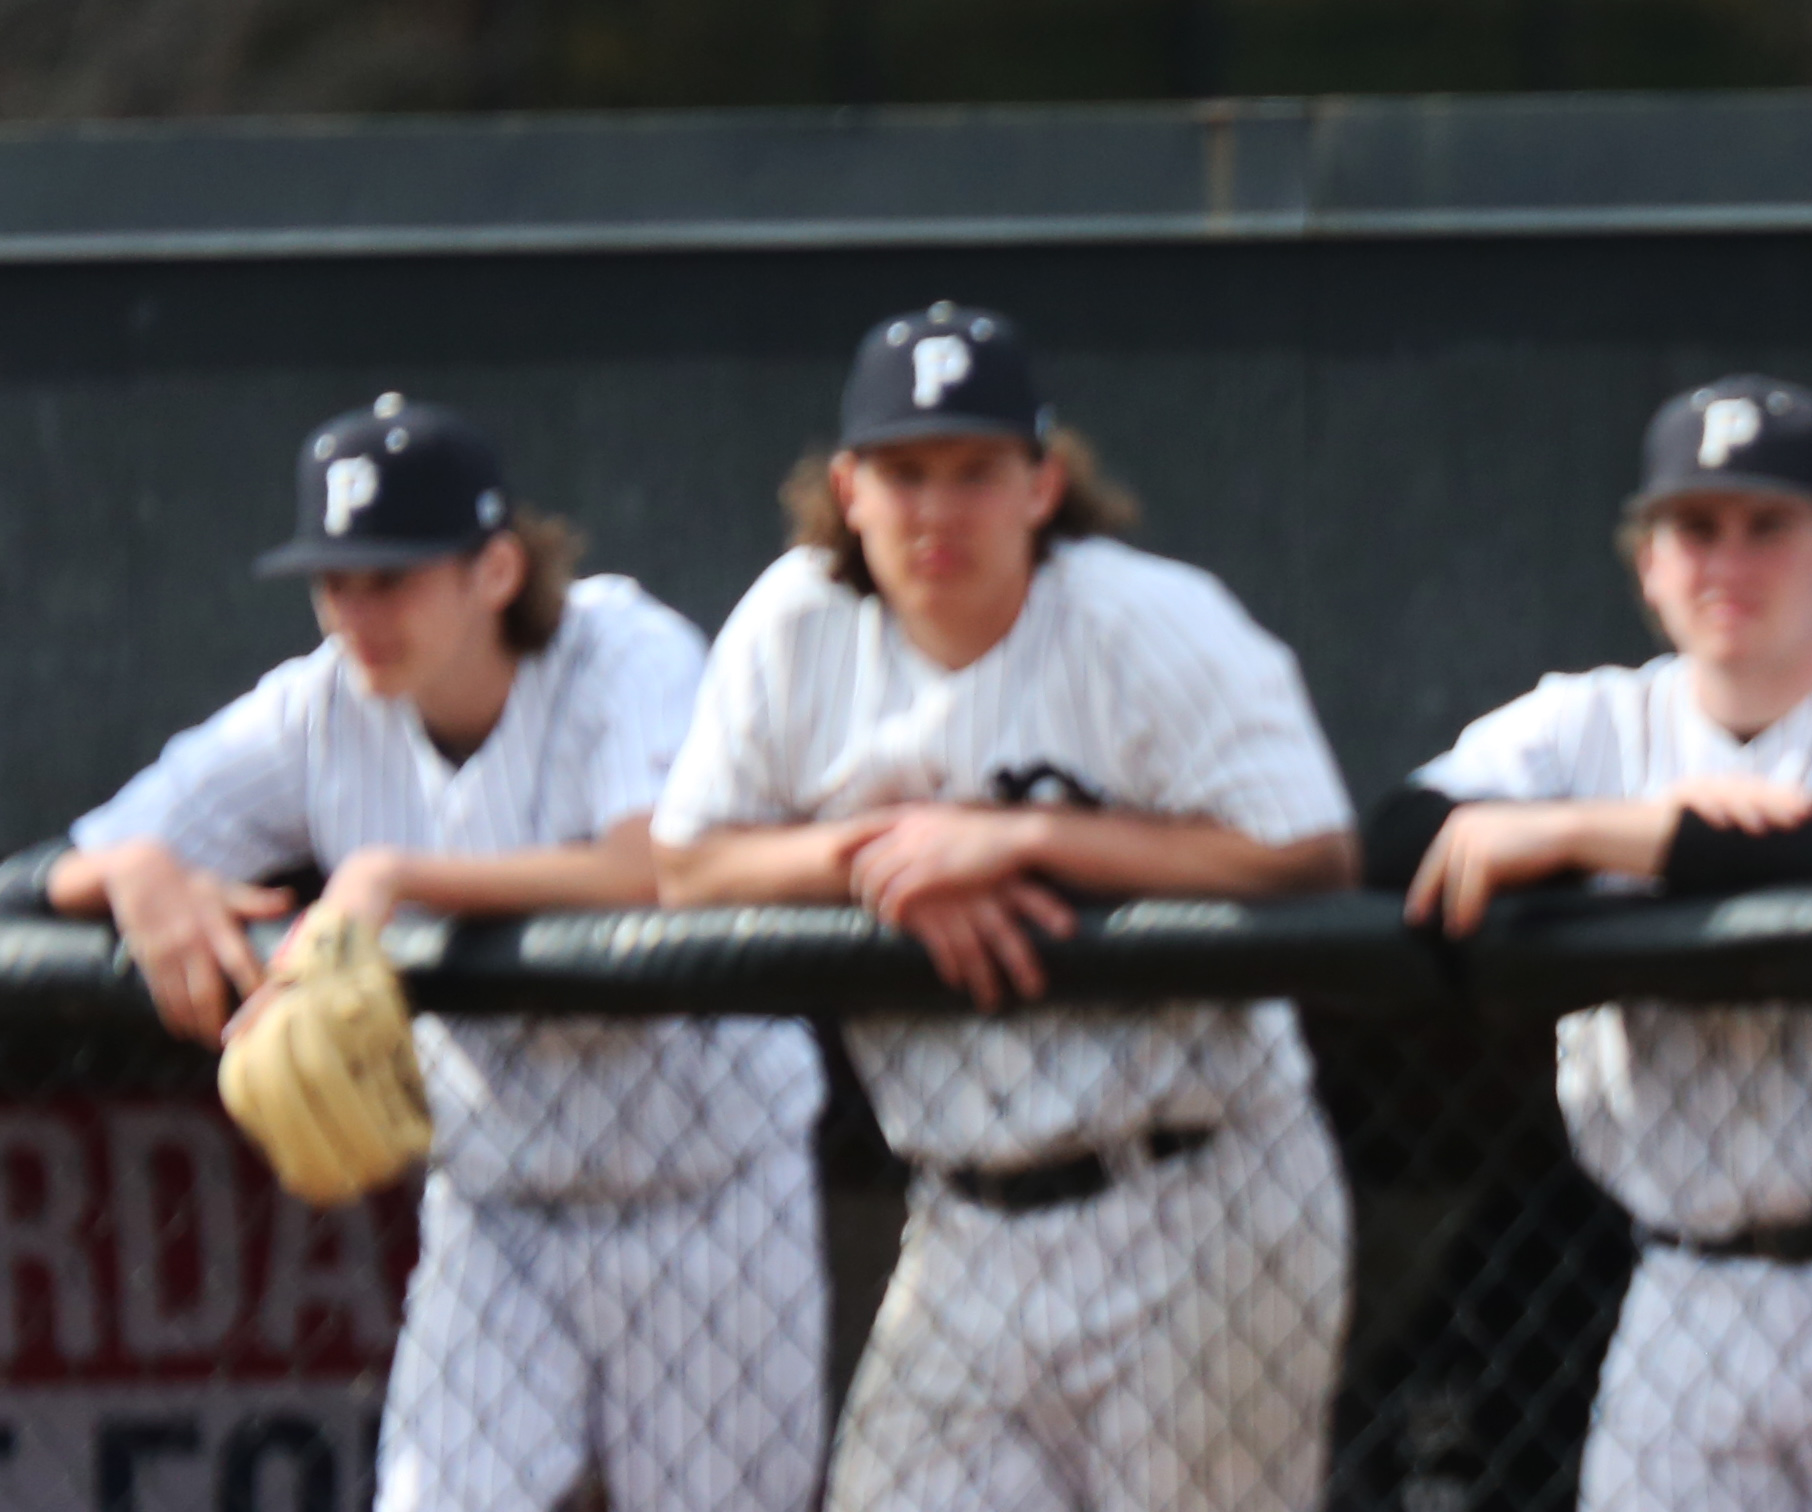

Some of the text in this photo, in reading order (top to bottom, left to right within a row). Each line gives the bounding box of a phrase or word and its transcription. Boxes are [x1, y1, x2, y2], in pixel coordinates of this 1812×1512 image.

[912, 335, 972, 409] P
[1698, 397, 1760, 468] P
[325, 457, 379, 536] P
